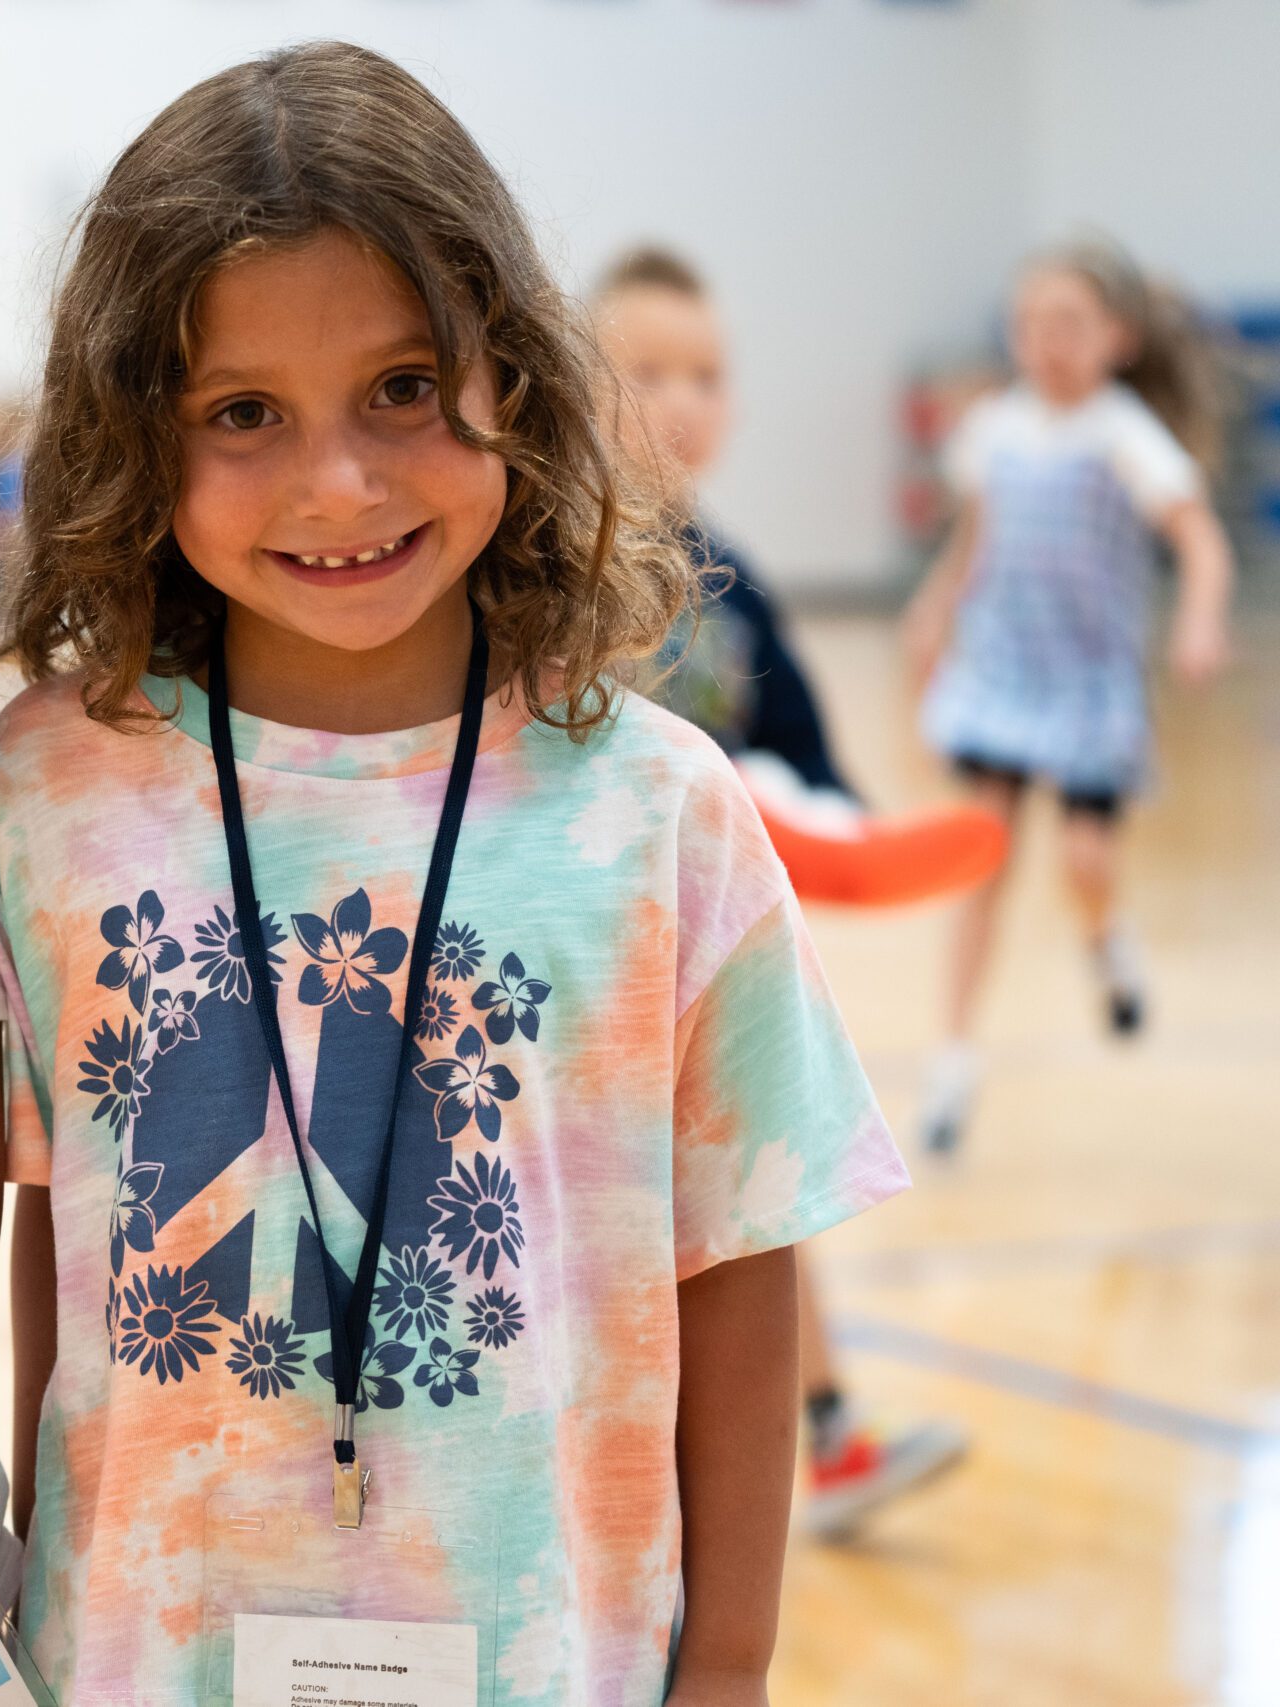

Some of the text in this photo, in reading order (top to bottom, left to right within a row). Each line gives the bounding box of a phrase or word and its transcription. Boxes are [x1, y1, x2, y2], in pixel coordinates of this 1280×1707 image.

[292, 1659, 408, 1674] Self-Adhesive Name Badge
[291, 1684, 329, 1693] CAUTION:
[291, 1696, 322, 1704] Adhesive
[323, 1698, 337, 1706] may
[339, 1698, 365, 1707] damage
